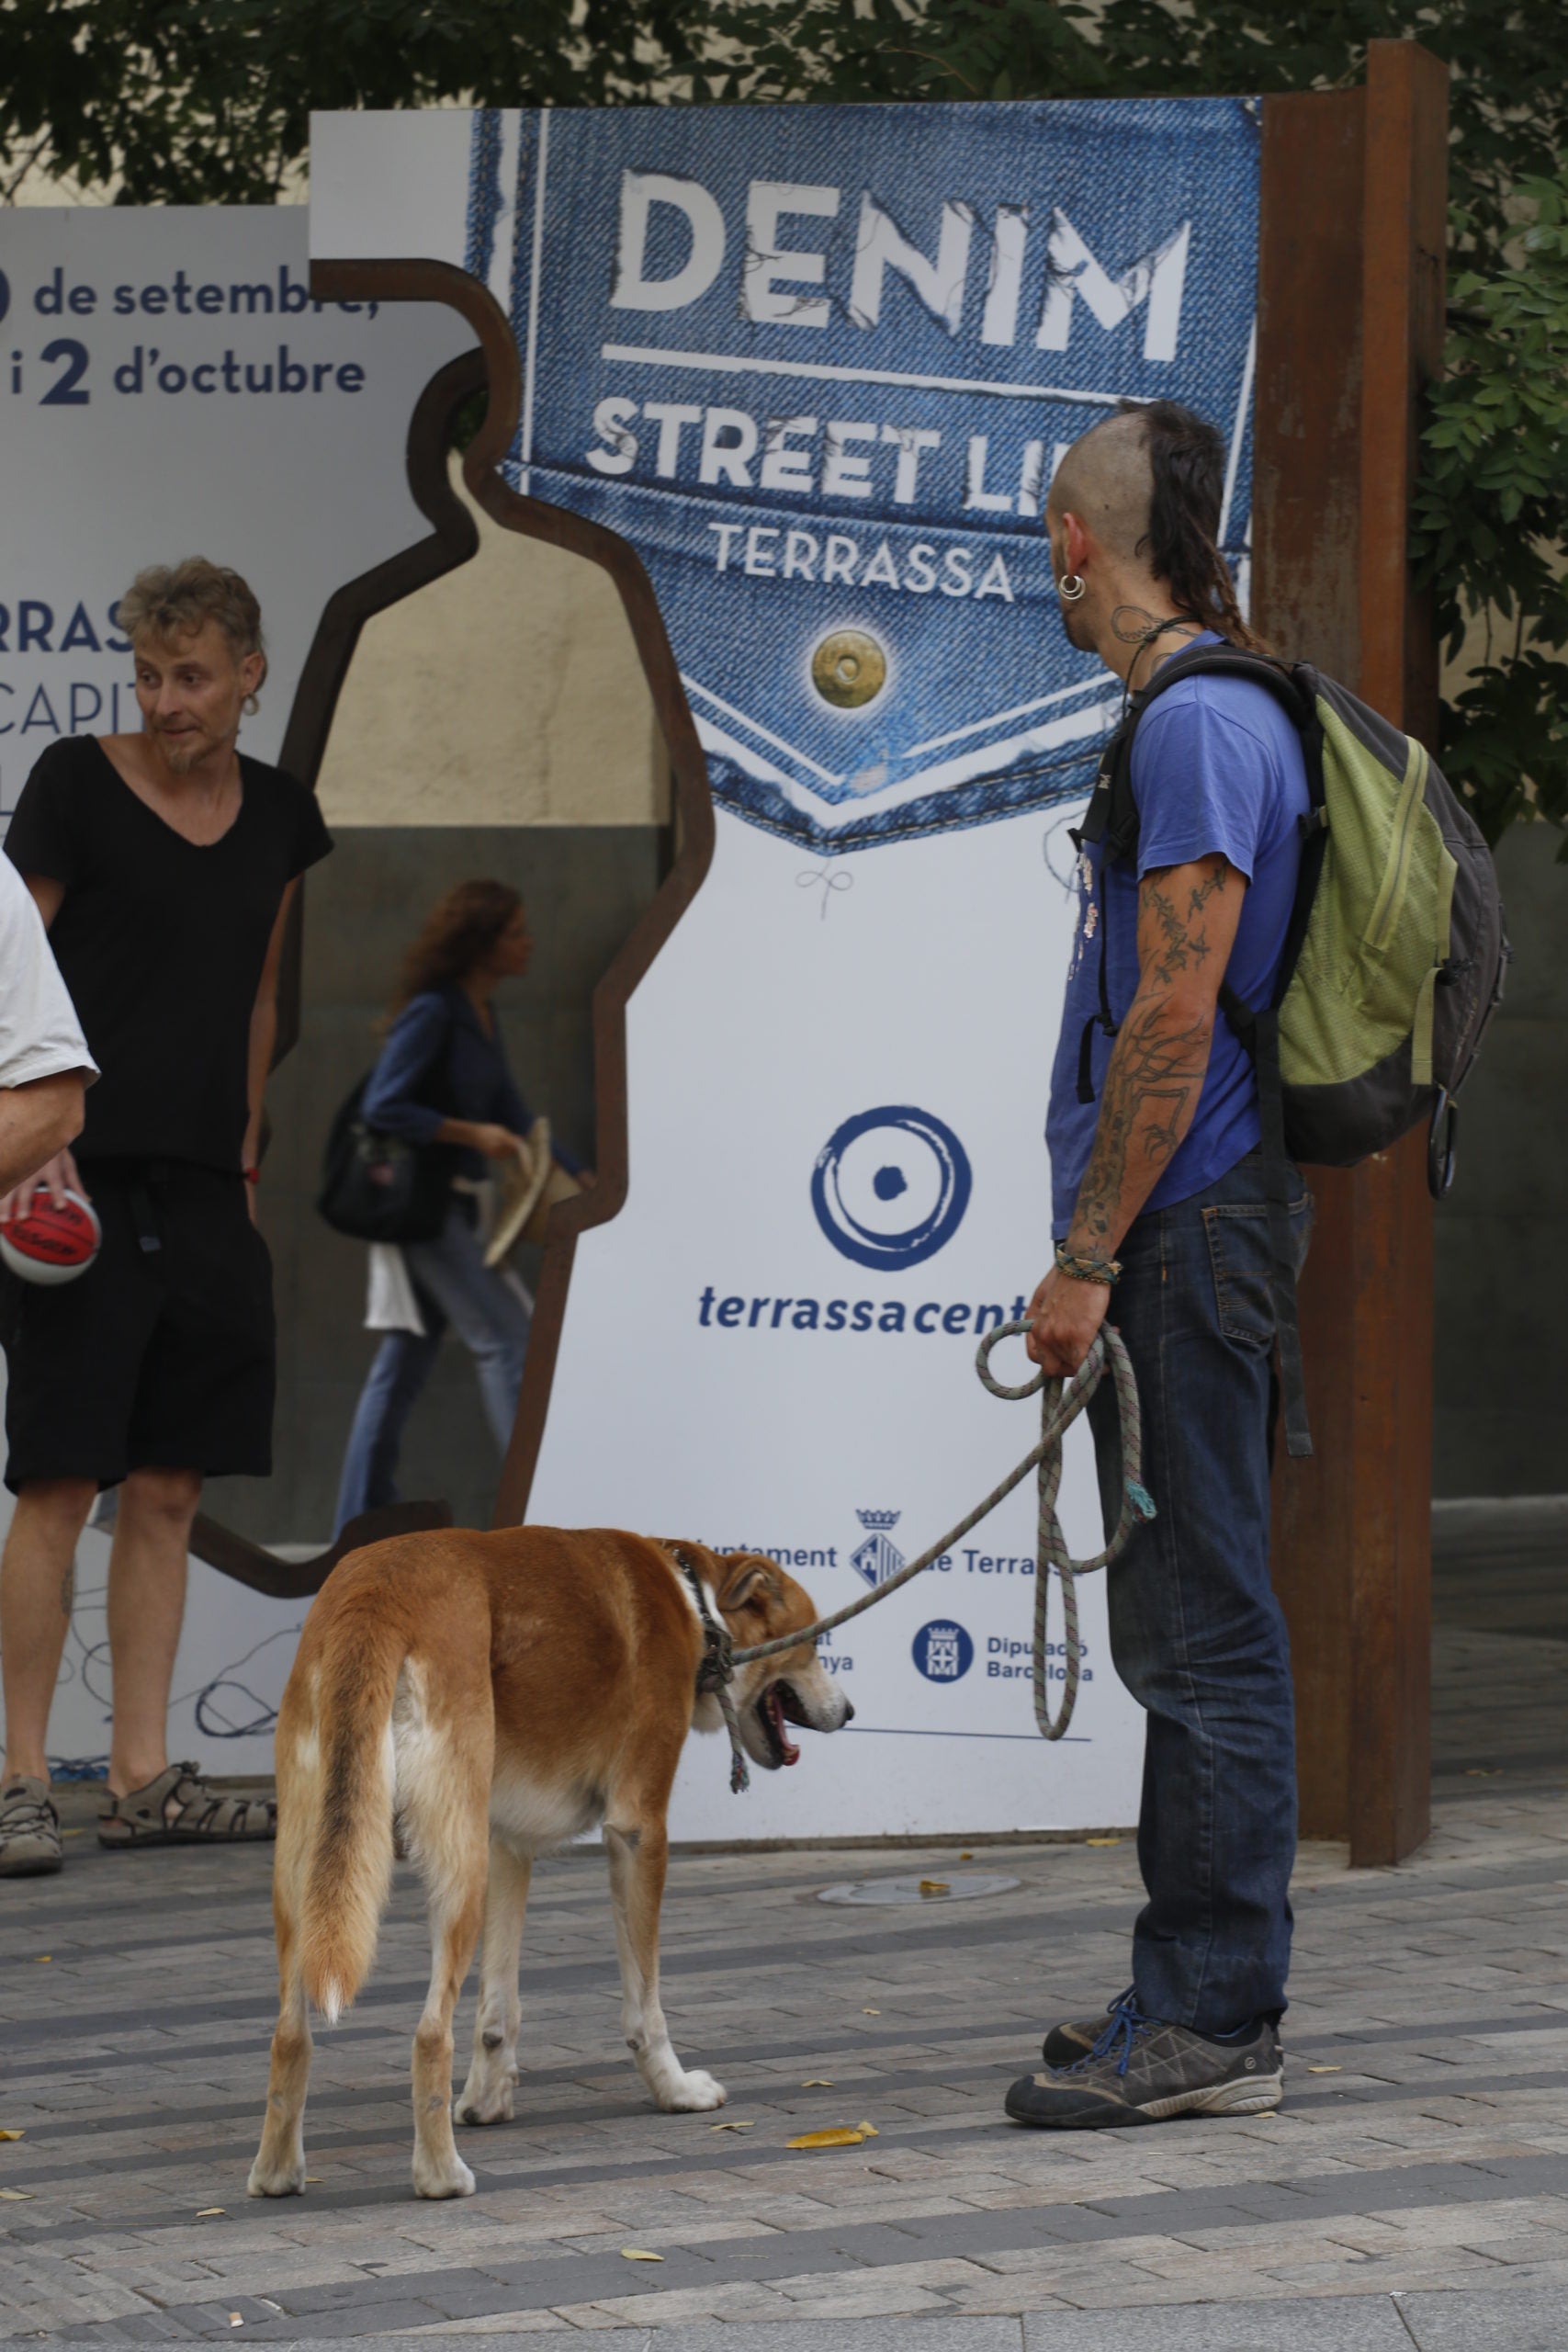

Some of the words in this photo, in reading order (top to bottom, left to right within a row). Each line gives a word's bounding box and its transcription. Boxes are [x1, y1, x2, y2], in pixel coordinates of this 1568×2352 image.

[34, 266, 97, 316] de
[609, 169, 1191, 362] DENIM
[11, 350, 22, 395] i
[39, 337, 90, 406] 2
[585, 396, 940, 504] STREET
[707, 522, 1016, 603] TERRASSA
[986, 1660, 1094, 1682] Barcloa
